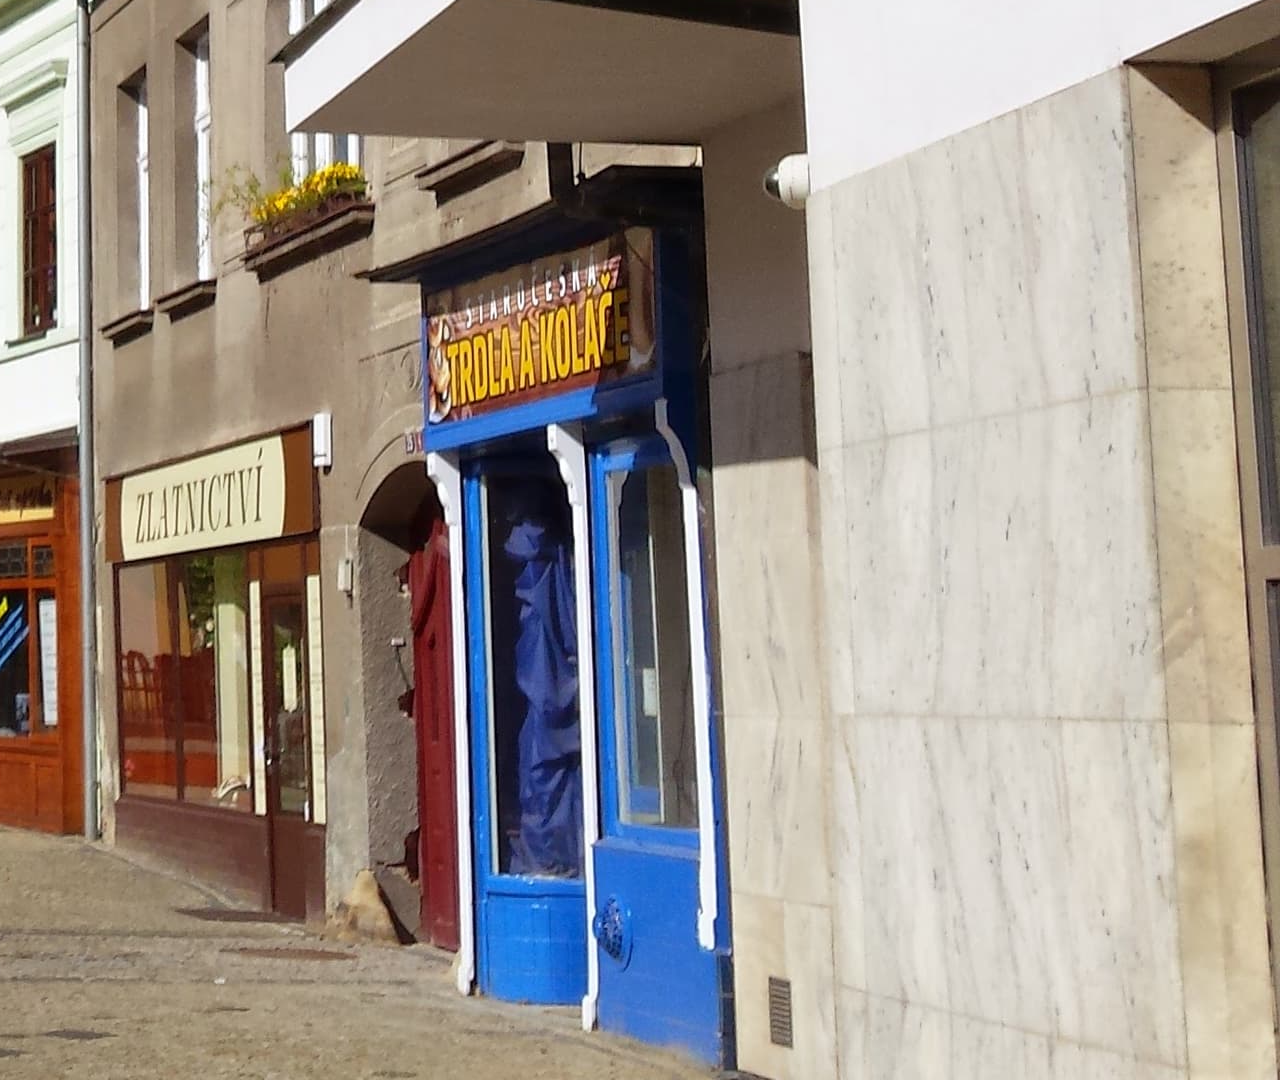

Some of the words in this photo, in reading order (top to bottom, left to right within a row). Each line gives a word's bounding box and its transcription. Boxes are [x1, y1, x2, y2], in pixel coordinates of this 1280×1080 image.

[446, 323, 516, 408] TRDLA
[518, 317, 536, 391] A
[135, 447, 264, 545] ZLATNICTVÍ
